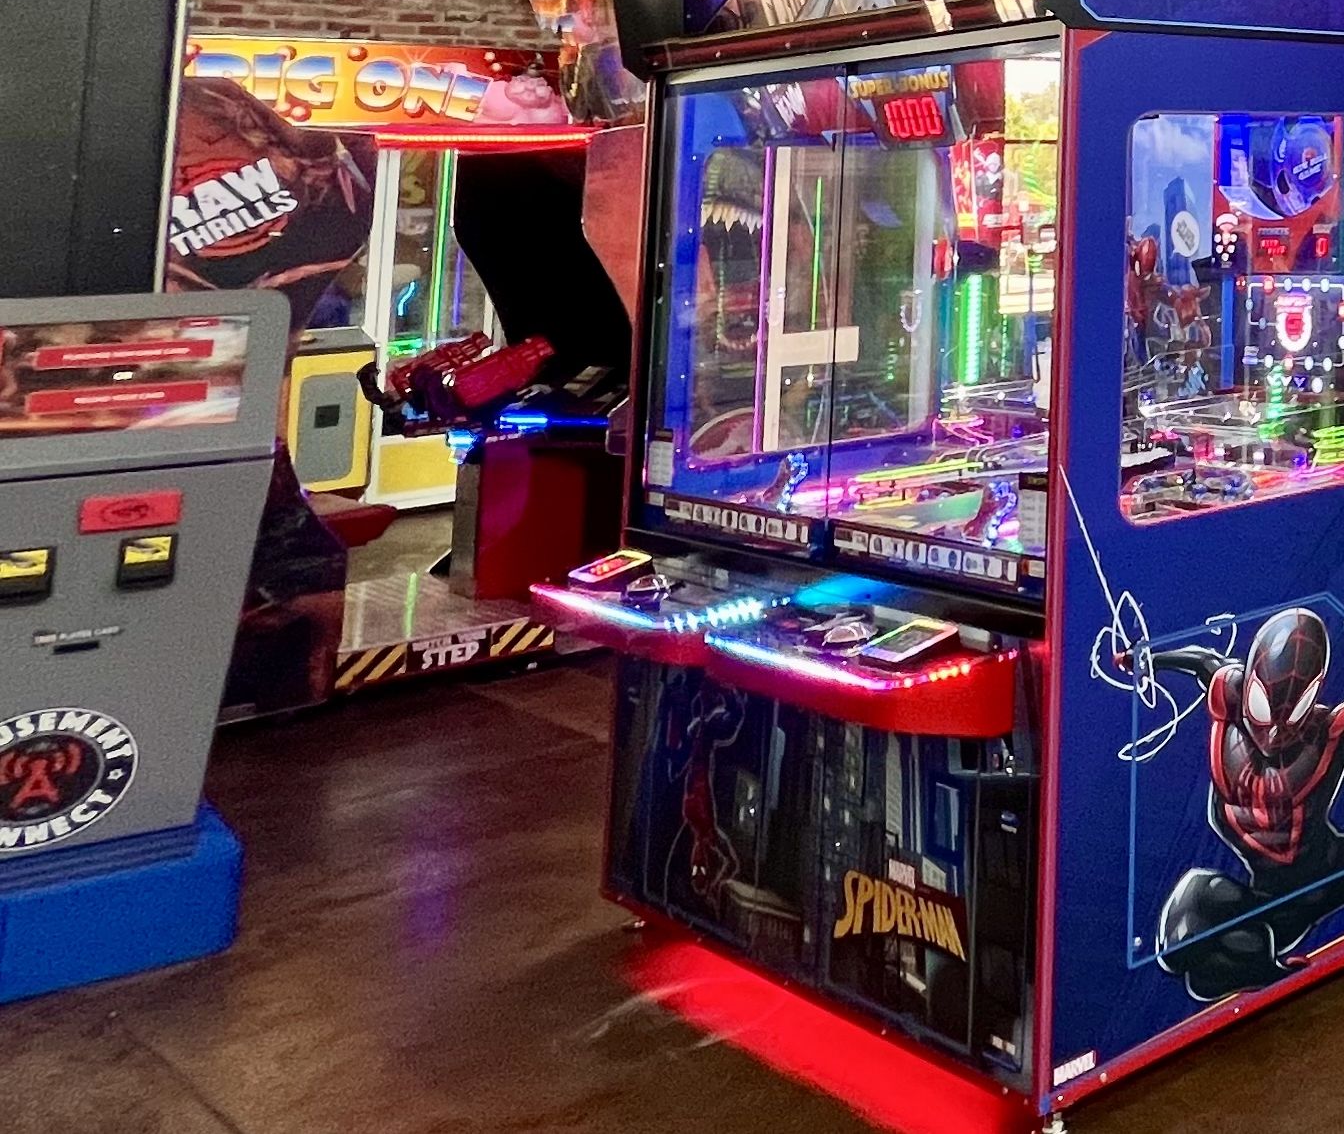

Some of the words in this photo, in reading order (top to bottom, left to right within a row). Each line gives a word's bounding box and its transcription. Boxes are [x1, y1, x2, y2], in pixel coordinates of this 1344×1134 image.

[193, 52, 339, 109] BIG
[354, 56, 493, 122] ONE
[884, 96, 944, 139] 1000
[169, 188, 299, 257] THRILLS
[171, 157, 281, 234] RAW
[421, 640, 480, 670] STEP
[833, 869, 967, 962] SPIDER-MAN
